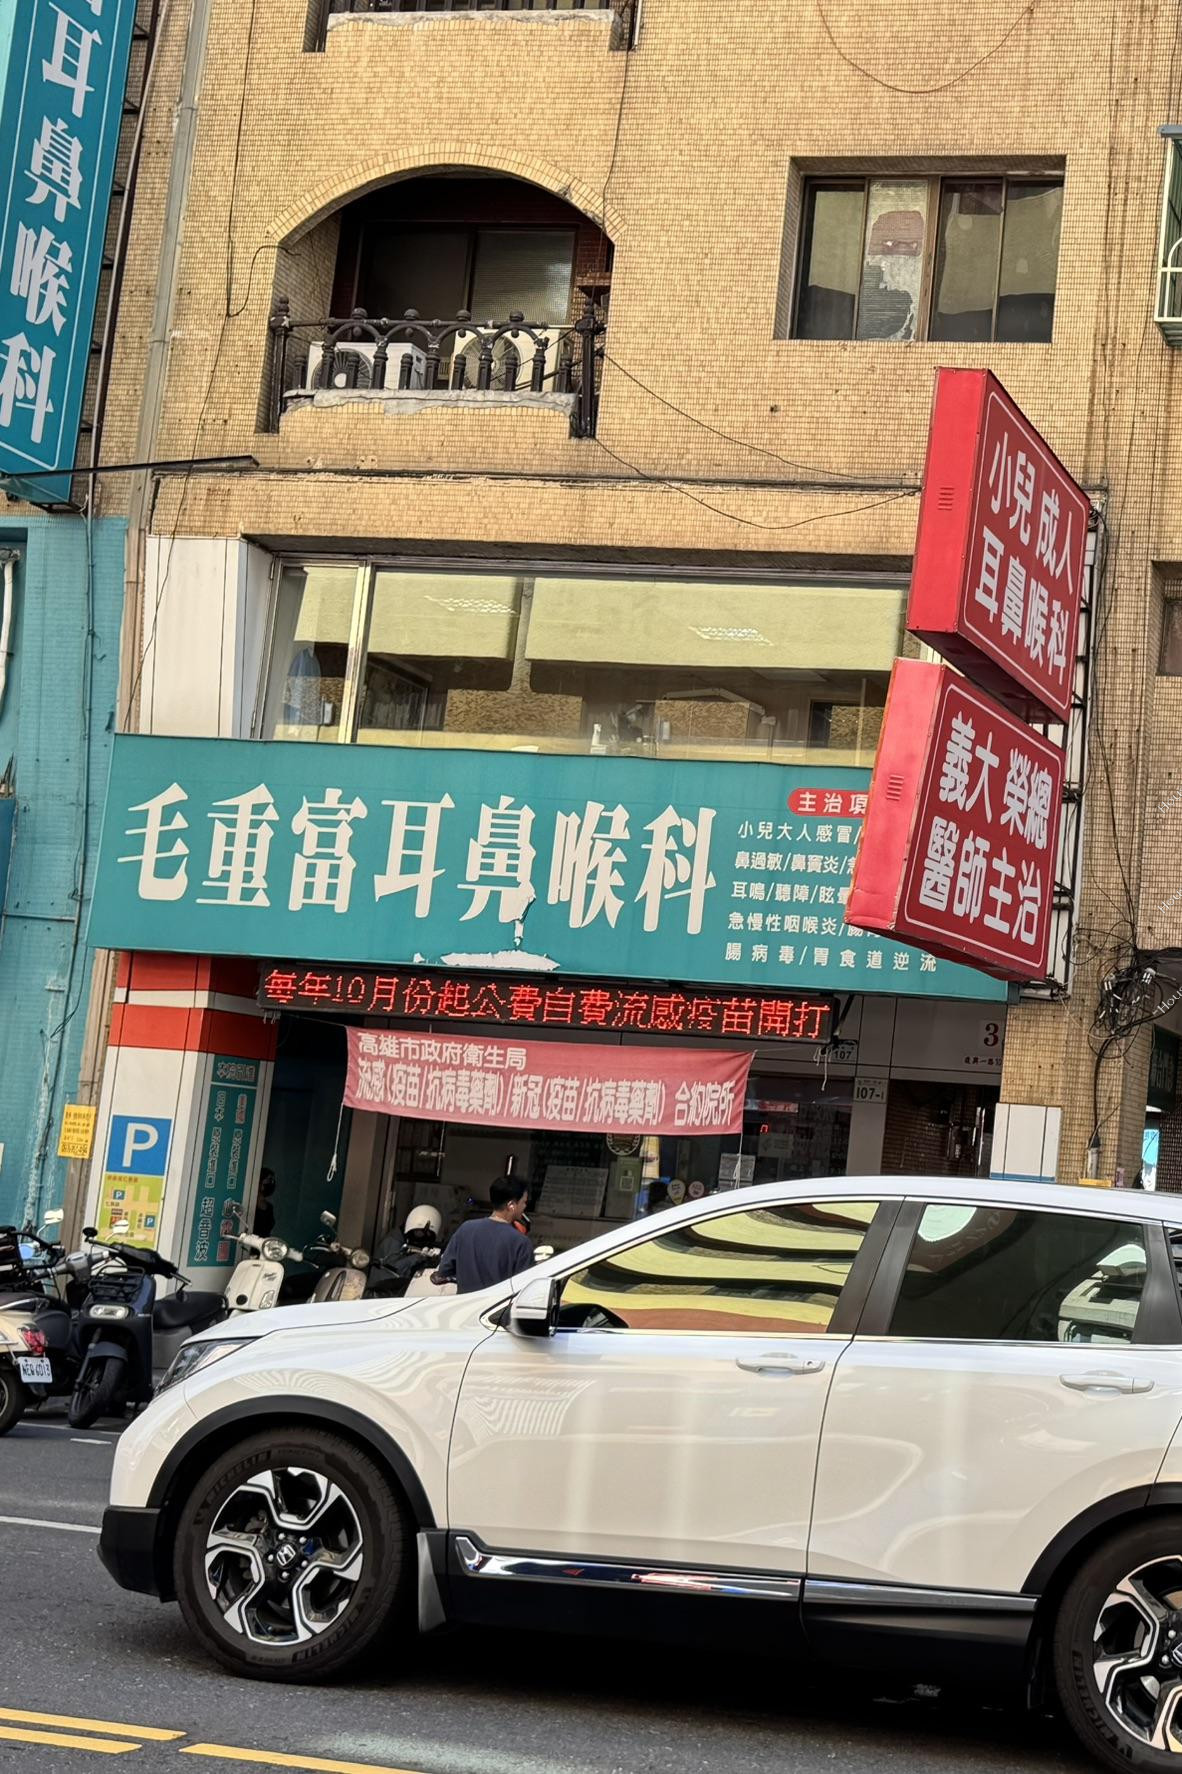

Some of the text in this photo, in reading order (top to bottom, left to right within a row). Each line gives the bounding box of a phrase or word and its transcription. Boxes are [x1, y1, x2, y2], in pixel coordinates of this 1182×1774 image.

[0, 0, 103, 445] 耳鼻喉科
[988, 431, 1075, 595] 小兒 成人
[974, 525, 1070, 686] 耳鼻喉科
[938, 710, 1053, 850] 義大 榮總
[117, 781, 717, 936] 毛重富耳鼻喉科
[918, 815, 1042, 946] 醫師主治
[263, 969, 831, 1040] 每年10月份起公費自費流感疫苗開打
[725, 942, 937, 973] 腸病毒/胃食道逆流
[357, 1031, 528, 1072] 高雄市政府衛生局
[983, 1022, 1005, 1047] 3
[121, 1122, 159, 1168] P
[673, 1080, 736, 1128] 合約院所
